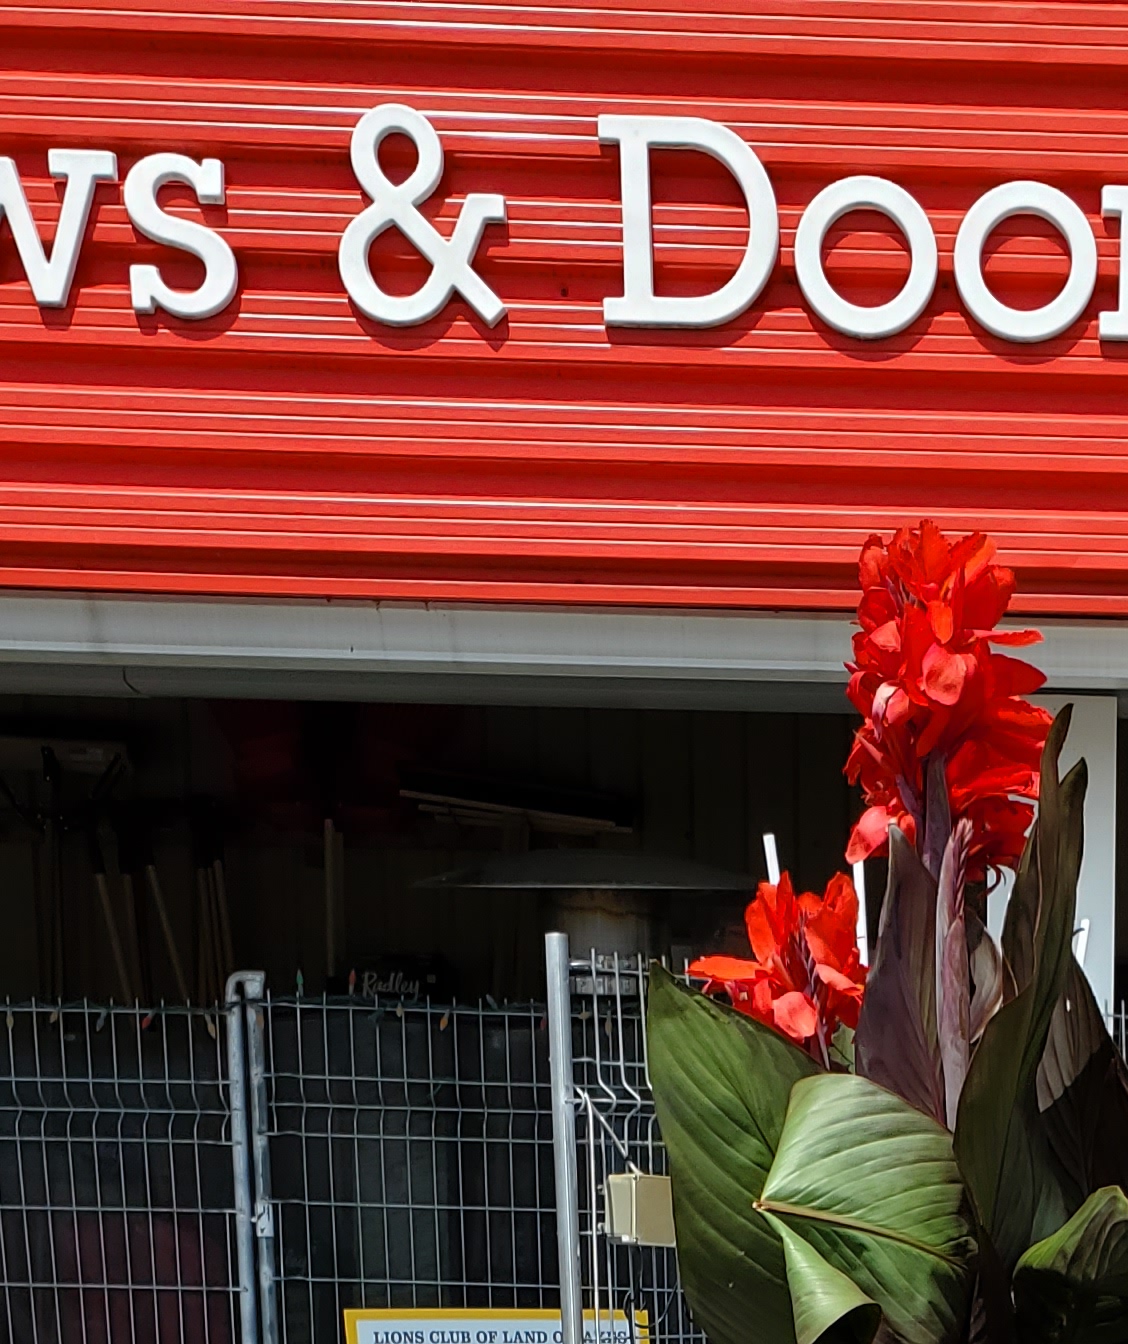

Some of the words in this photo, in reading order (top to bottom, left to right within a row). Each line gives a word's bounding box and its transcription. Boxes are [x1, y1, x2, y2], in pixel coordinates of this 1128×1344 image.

[337, 103, 508, 328] &
[362, 971, 419, 1002] Radley
[373, 1330, 425, 1344] LIONS
[429, 1330, 471, 1344] CLUB
[475, 1330, 498, 1344] OF
[502, 1330, 548, 1344] LAND
